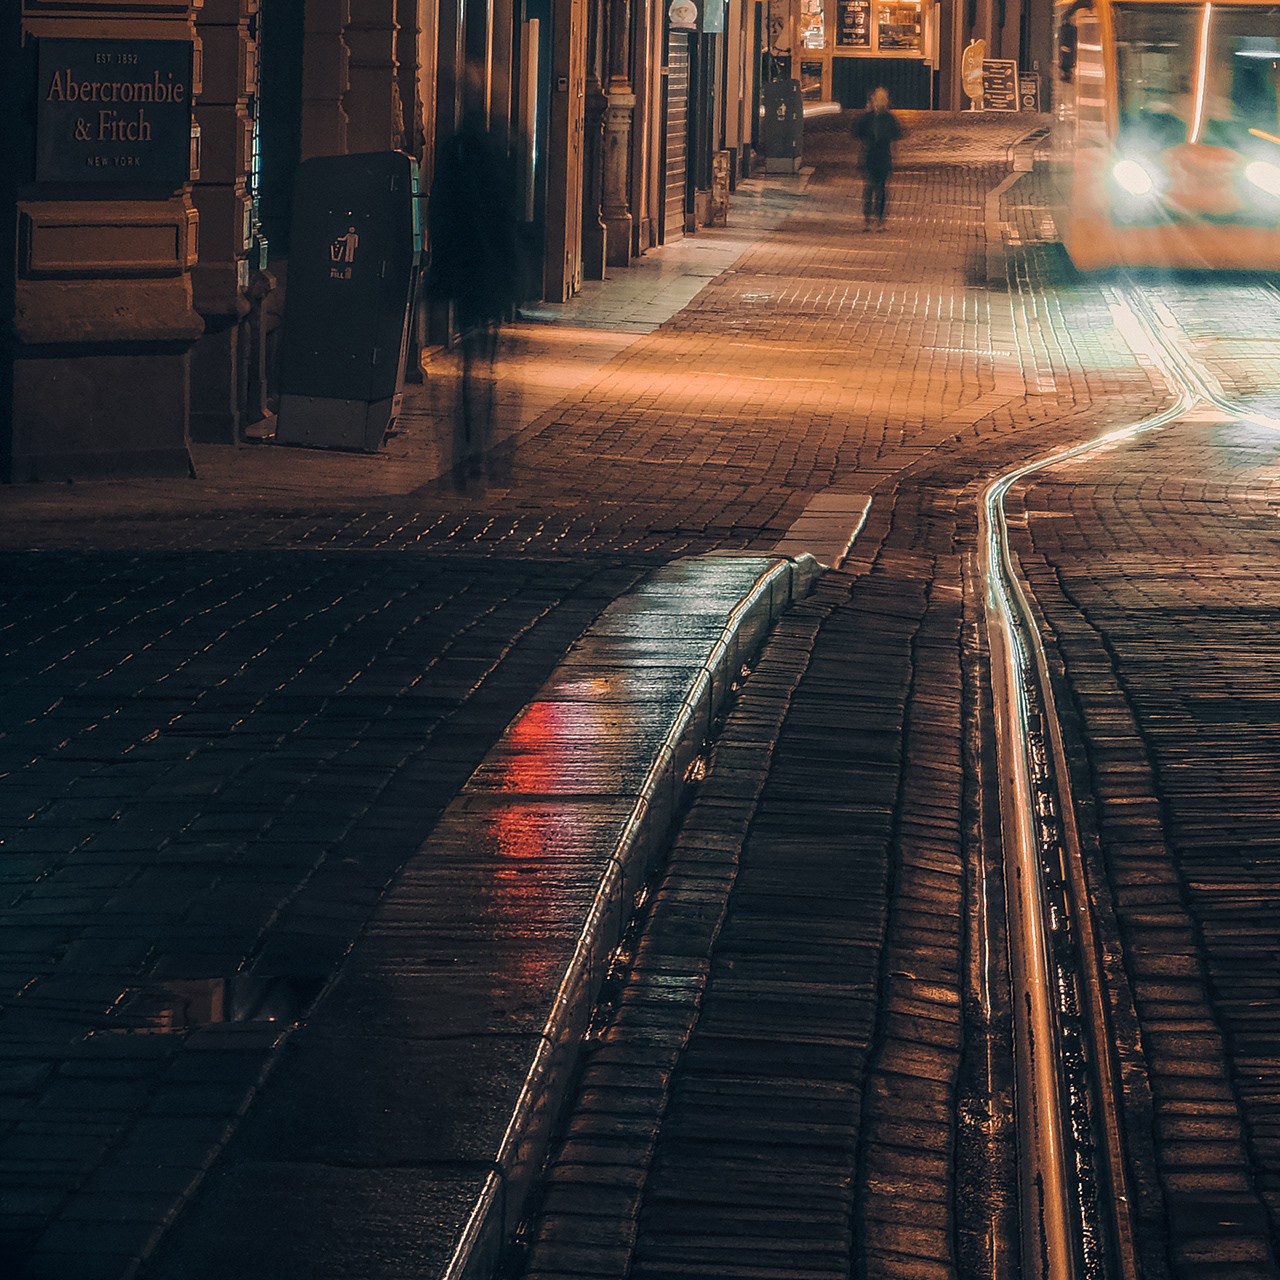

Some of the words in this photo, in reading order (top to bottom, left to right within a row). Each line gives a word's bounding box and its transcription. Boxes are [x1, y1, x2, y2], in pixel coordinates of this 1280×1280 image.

[117, 53, 138, 64] 1892
[46, 68, 185, 103] Abercrombie
[74, 117, 92, 141] &
[97, 108, 152, 141] Fitch
[87, 156, 108, 167] NEW
[113, 156, 141, 167] YORK
